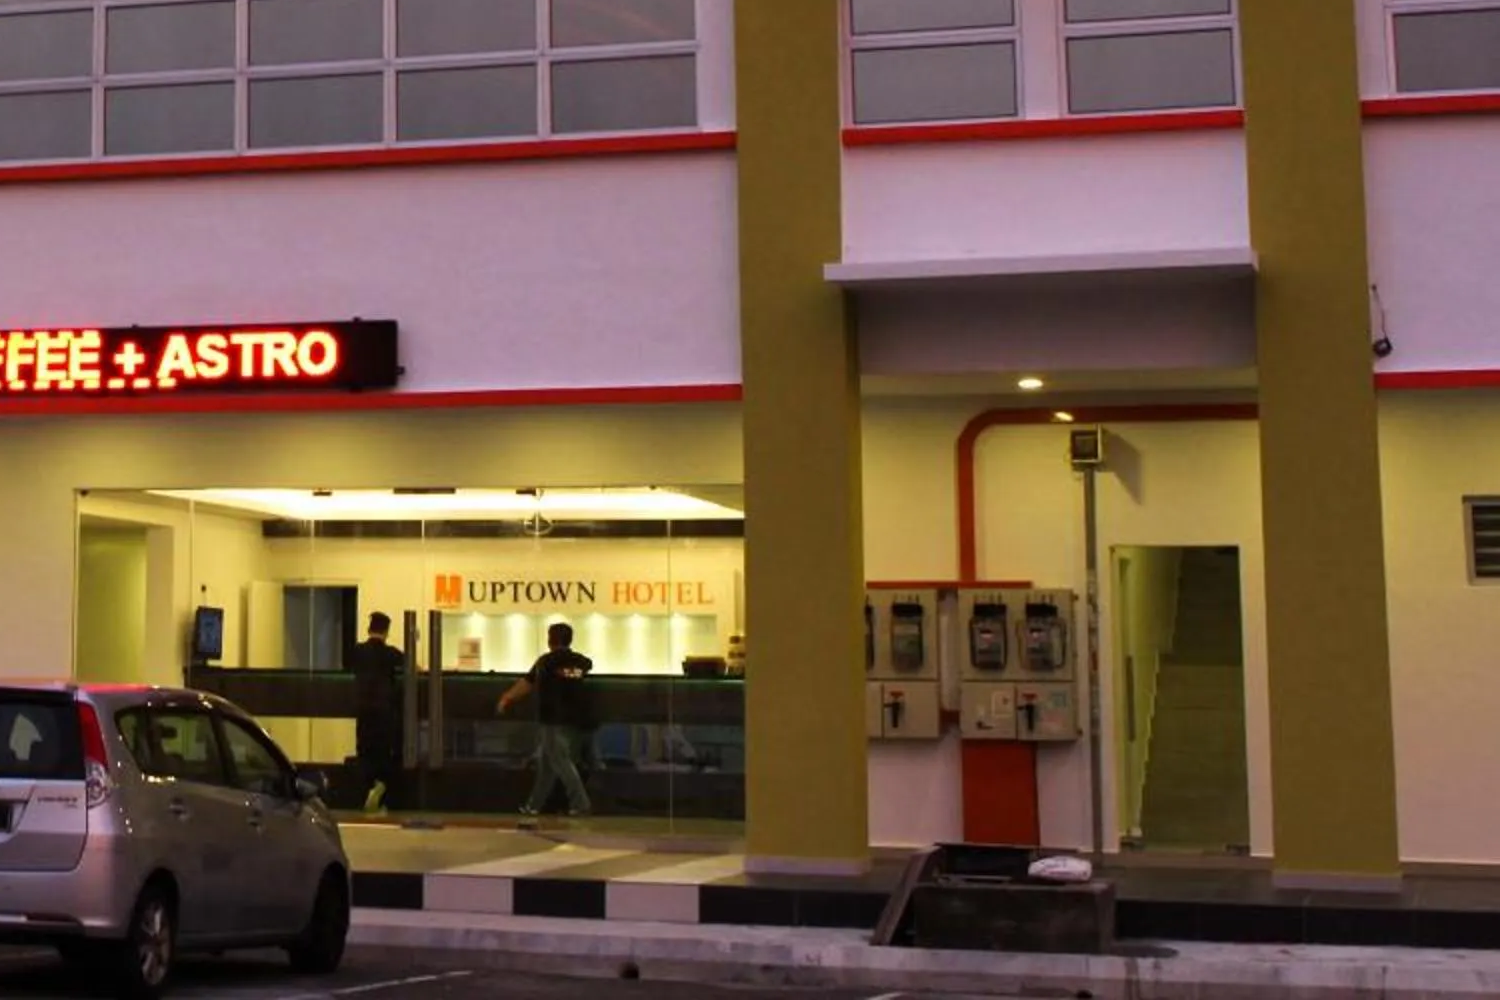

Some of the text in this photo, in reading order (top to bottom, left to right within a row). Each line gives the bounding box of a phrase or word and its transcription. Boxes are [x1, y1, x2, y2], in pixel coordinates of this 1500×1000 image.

[158, 331, 339, 380] ASTRO
[468, 580, 714, 604] UPTOWN HOTEL
